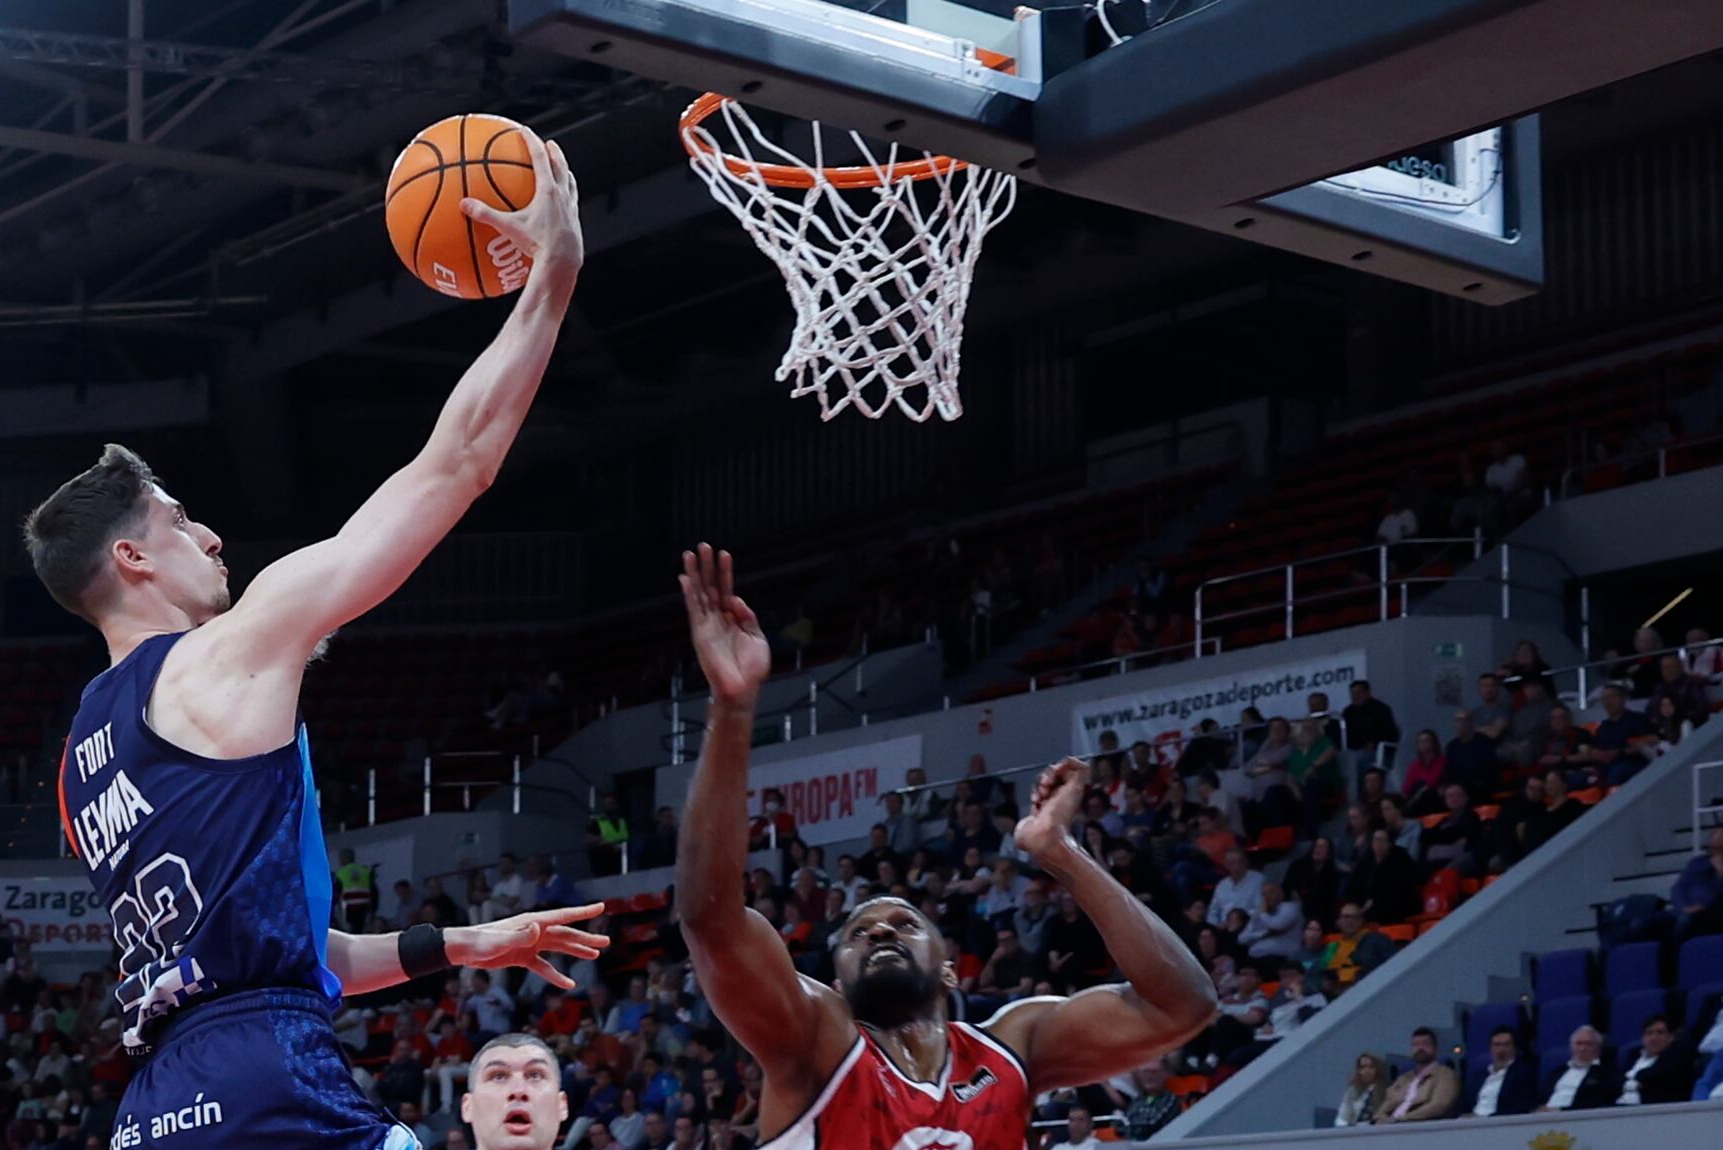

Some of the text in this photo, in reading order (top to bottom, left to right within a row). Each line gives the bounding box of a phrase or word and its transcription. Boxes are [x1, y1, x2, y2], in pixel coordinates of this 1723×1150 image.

[1082, 663, 1355, 732] www.zaragozadeporte.com
[75, 721, 114, 783] FONT
[73, 769, 154, 872] LEYMA
[150, 1092, 224, 1141] ancín
